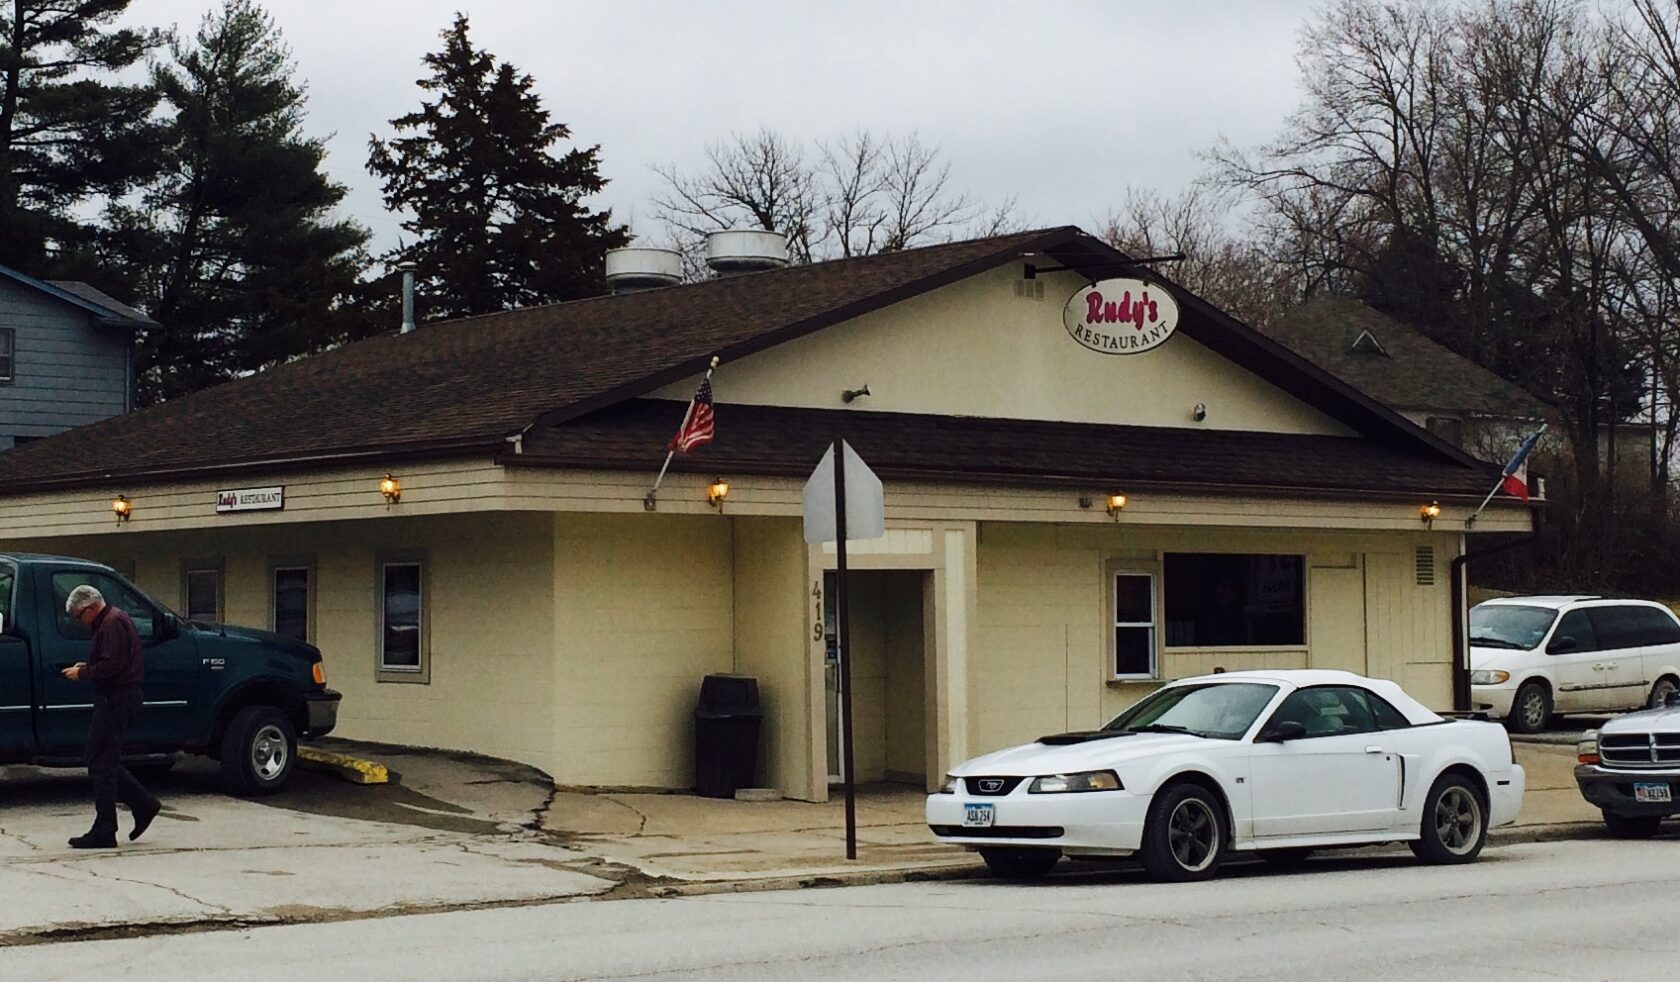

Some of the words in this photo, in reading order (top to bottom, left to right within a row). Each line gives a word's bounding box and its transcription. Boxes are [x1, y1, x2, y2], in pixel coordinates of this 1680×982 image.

[1086, 291, 1158, 331] Rudy's
[1074, 321, 1169, 349] RESTAURANT
[240, 493, 281, 504] RESTAURANT
[812, 581, 823, 642] 419
